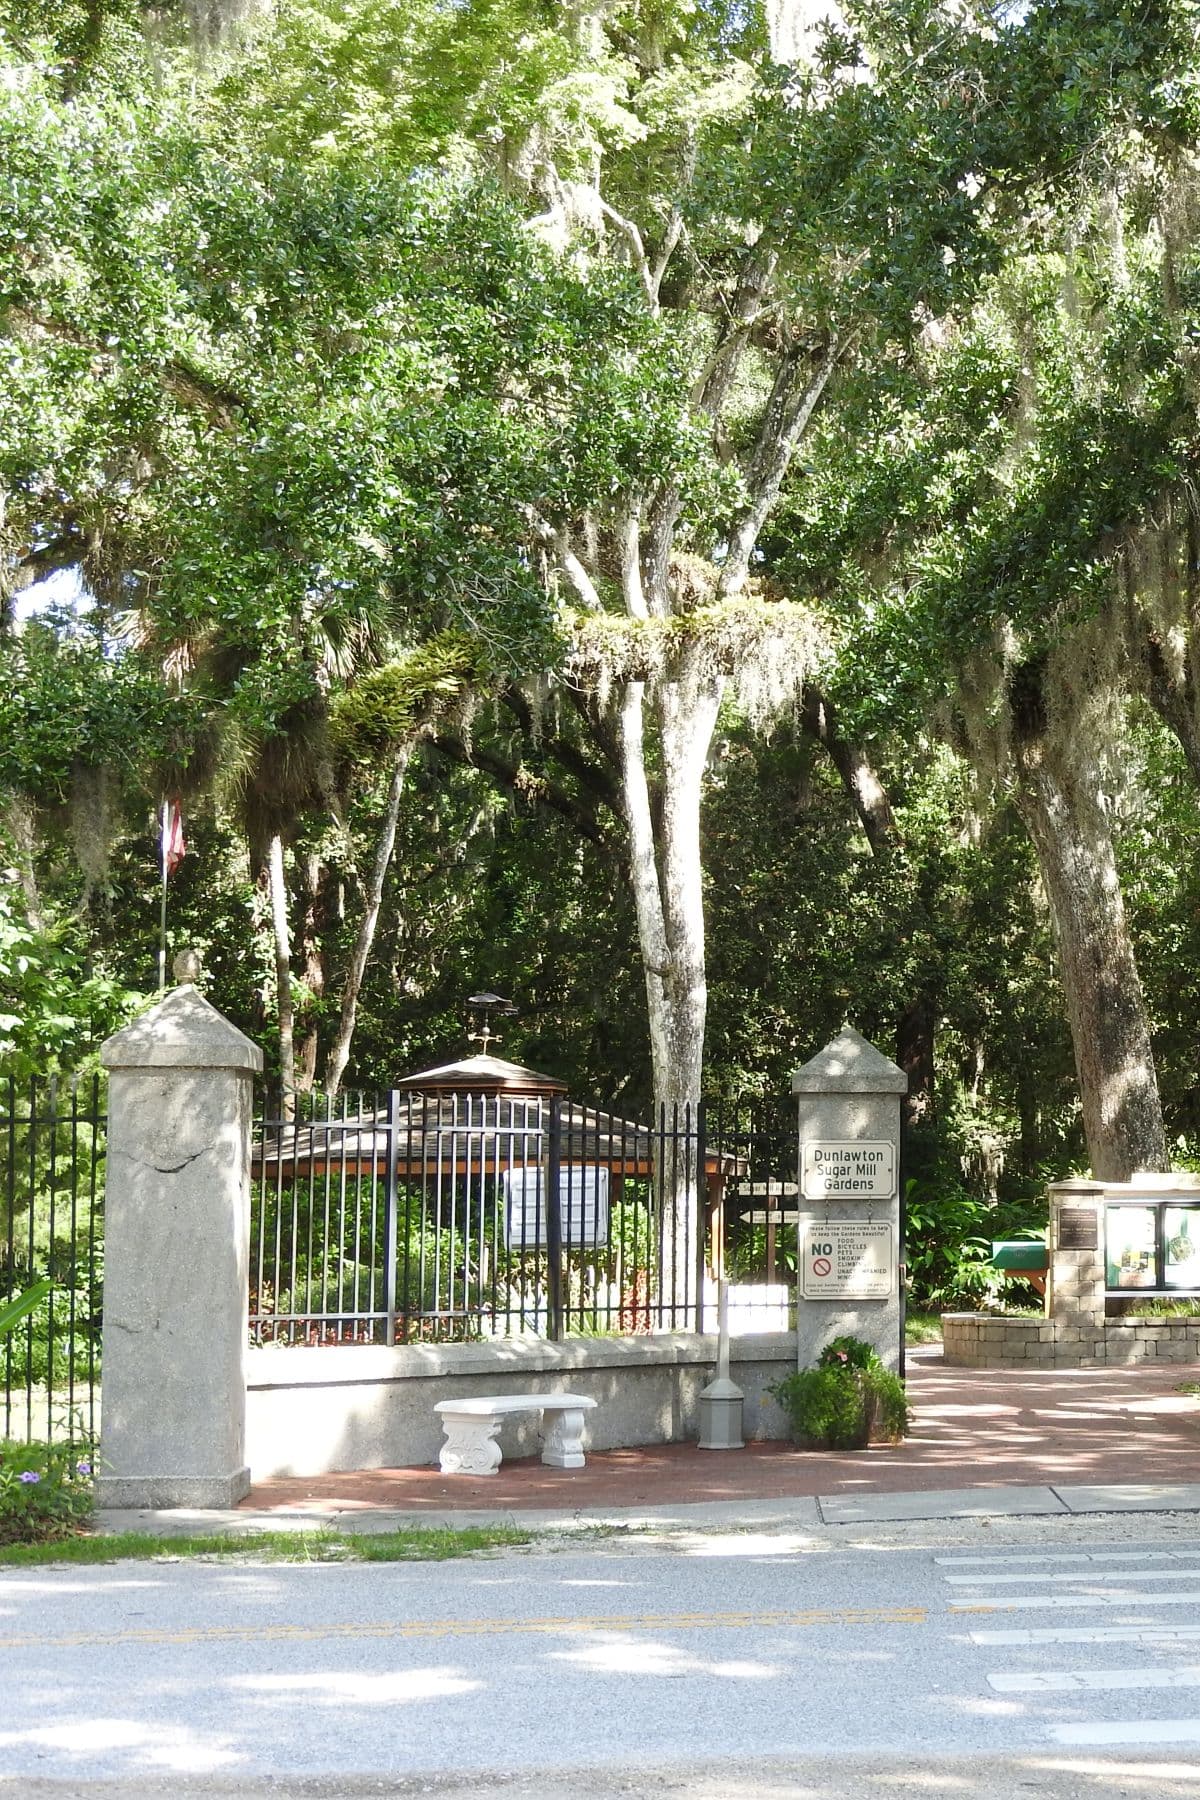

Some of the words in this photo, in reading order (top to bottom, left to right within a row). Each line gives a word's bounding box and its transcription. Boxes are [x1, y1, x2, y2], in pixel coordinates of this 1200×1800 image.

[814, 1149, 884, 1162] Dunlawton
[817, 1164, 852, 1179] Sugar
[856, 1164, 877, 1176] Mill
[824, 1178, 874, 1190] Gardens
[811, 1243, 833, 1256] NO
